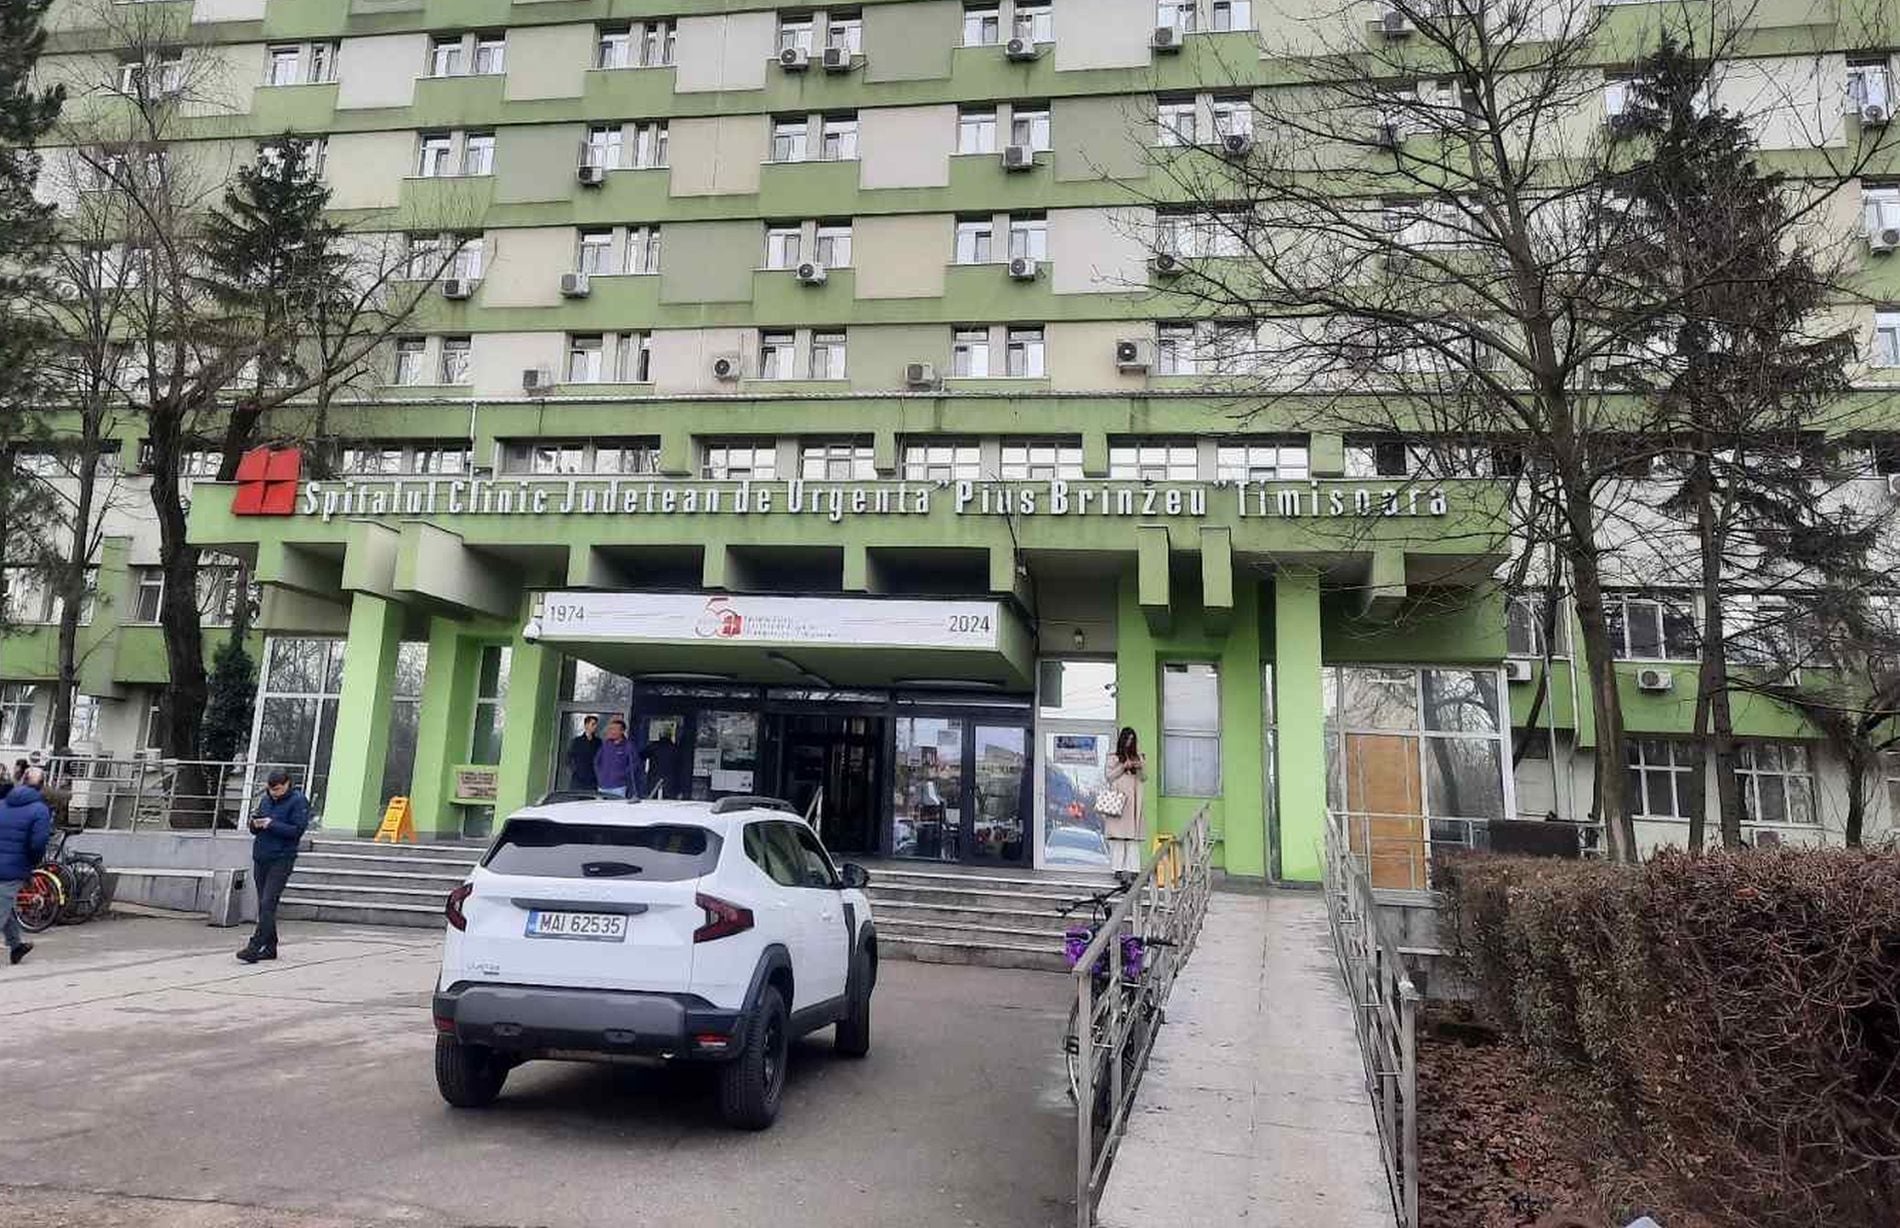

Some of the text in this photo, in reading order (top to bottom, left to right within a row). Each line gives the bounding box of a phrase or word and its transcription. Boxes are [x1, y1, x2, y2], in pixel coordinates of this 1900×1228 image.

[304, 480, 437, 523] Spitalul
[449, 480, 547, 514] Clinic
[559, 479, 720, 514] Judetean
[735, 479, 772, 514] de
[787, 479, 930, 523] Urgenta
[1235, 478, 1448, 517] Timisoara
[550, 604, 585, 622] 1974
[949, 614, 990, 633] 2024
[540, 914, 621, 934] MAI 62535
